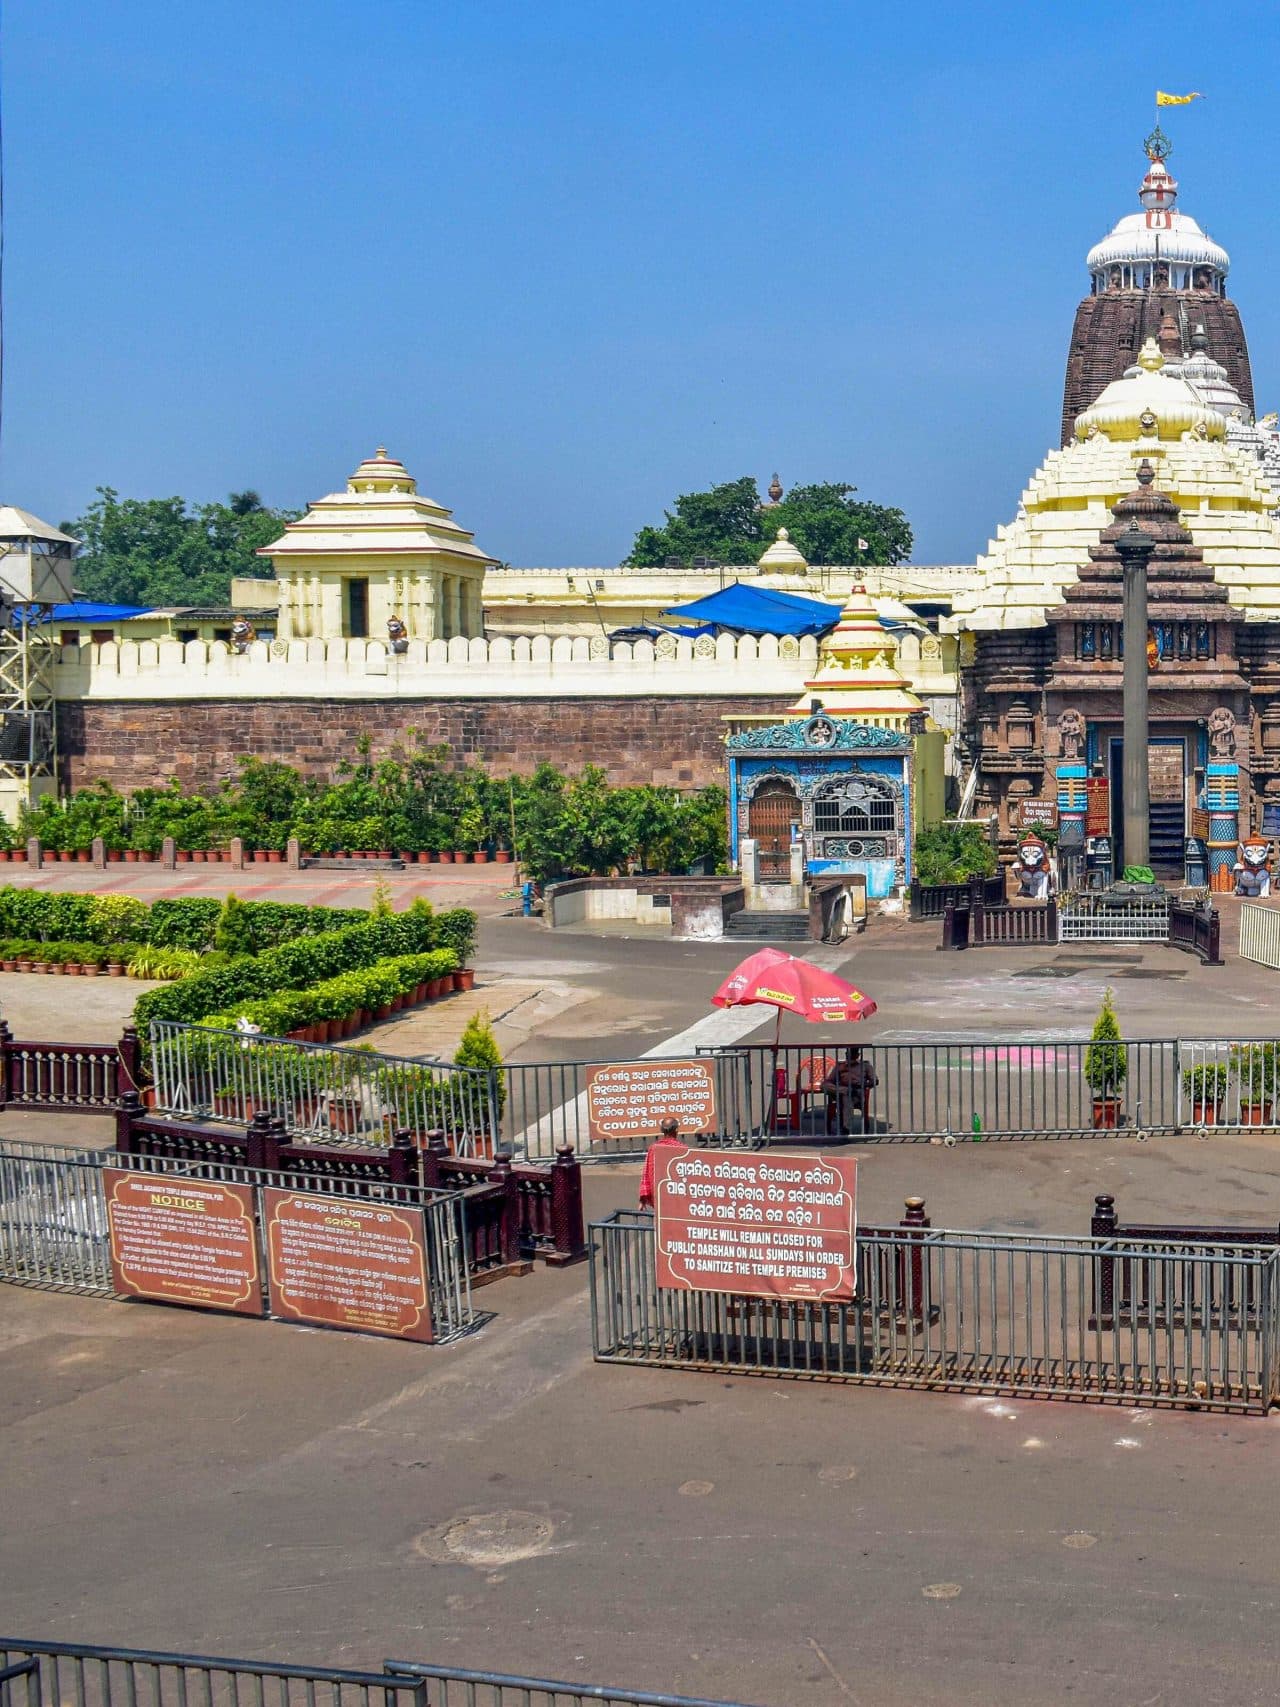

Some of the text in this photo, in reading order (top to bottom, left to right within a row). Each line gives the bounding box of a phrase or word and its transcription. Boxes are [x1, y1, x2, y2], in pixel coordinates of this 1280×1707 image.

[604, 1121, 638, 1130] COVID
[805, 1167, 834, 1185] କରିବା
[728, 1183, 764, 1201] ରବିବାର
[768, 1185, 784, 1201] ଦିନ
[151, 1194, 205, 1209] NOTICE
[687, 1227, 822, 1248] TEMPLE WILL REMAIN CLOSED FOR
[667, 1241, 844, 1266] PUBLIC DARSHAN ON ALL SUNDAYS IN ORDER
[684, 1258, 826, 1280] TO SANITIZE THE TEMPLE PREMISES
